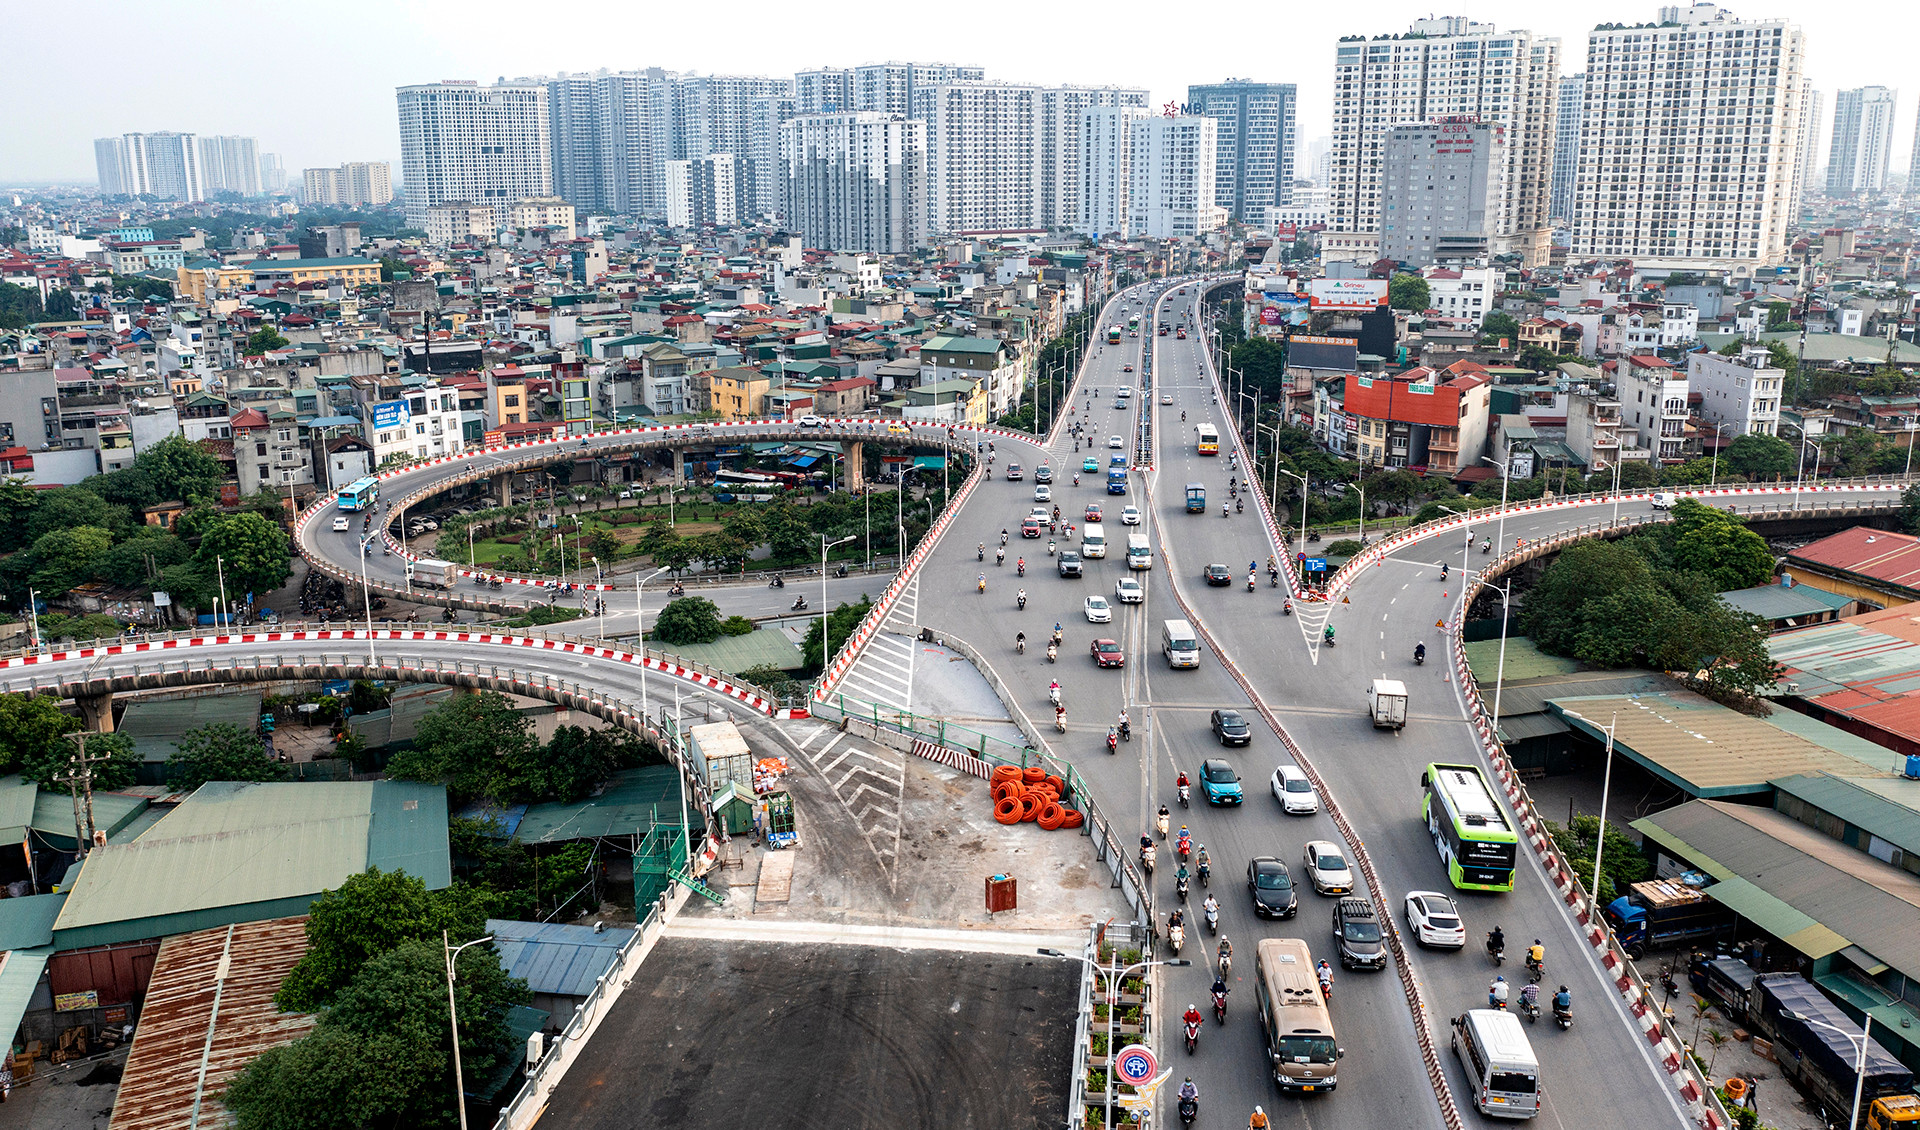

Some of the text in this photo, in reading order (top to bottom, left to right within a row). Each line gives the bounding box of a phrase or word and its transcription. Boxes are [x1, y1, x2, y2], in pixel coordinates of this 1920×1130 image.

[1180, 103, 1202, 115] MB
[890, 114, 905, 122] Clara
[1442, 125, 1468, 133] & SPA
